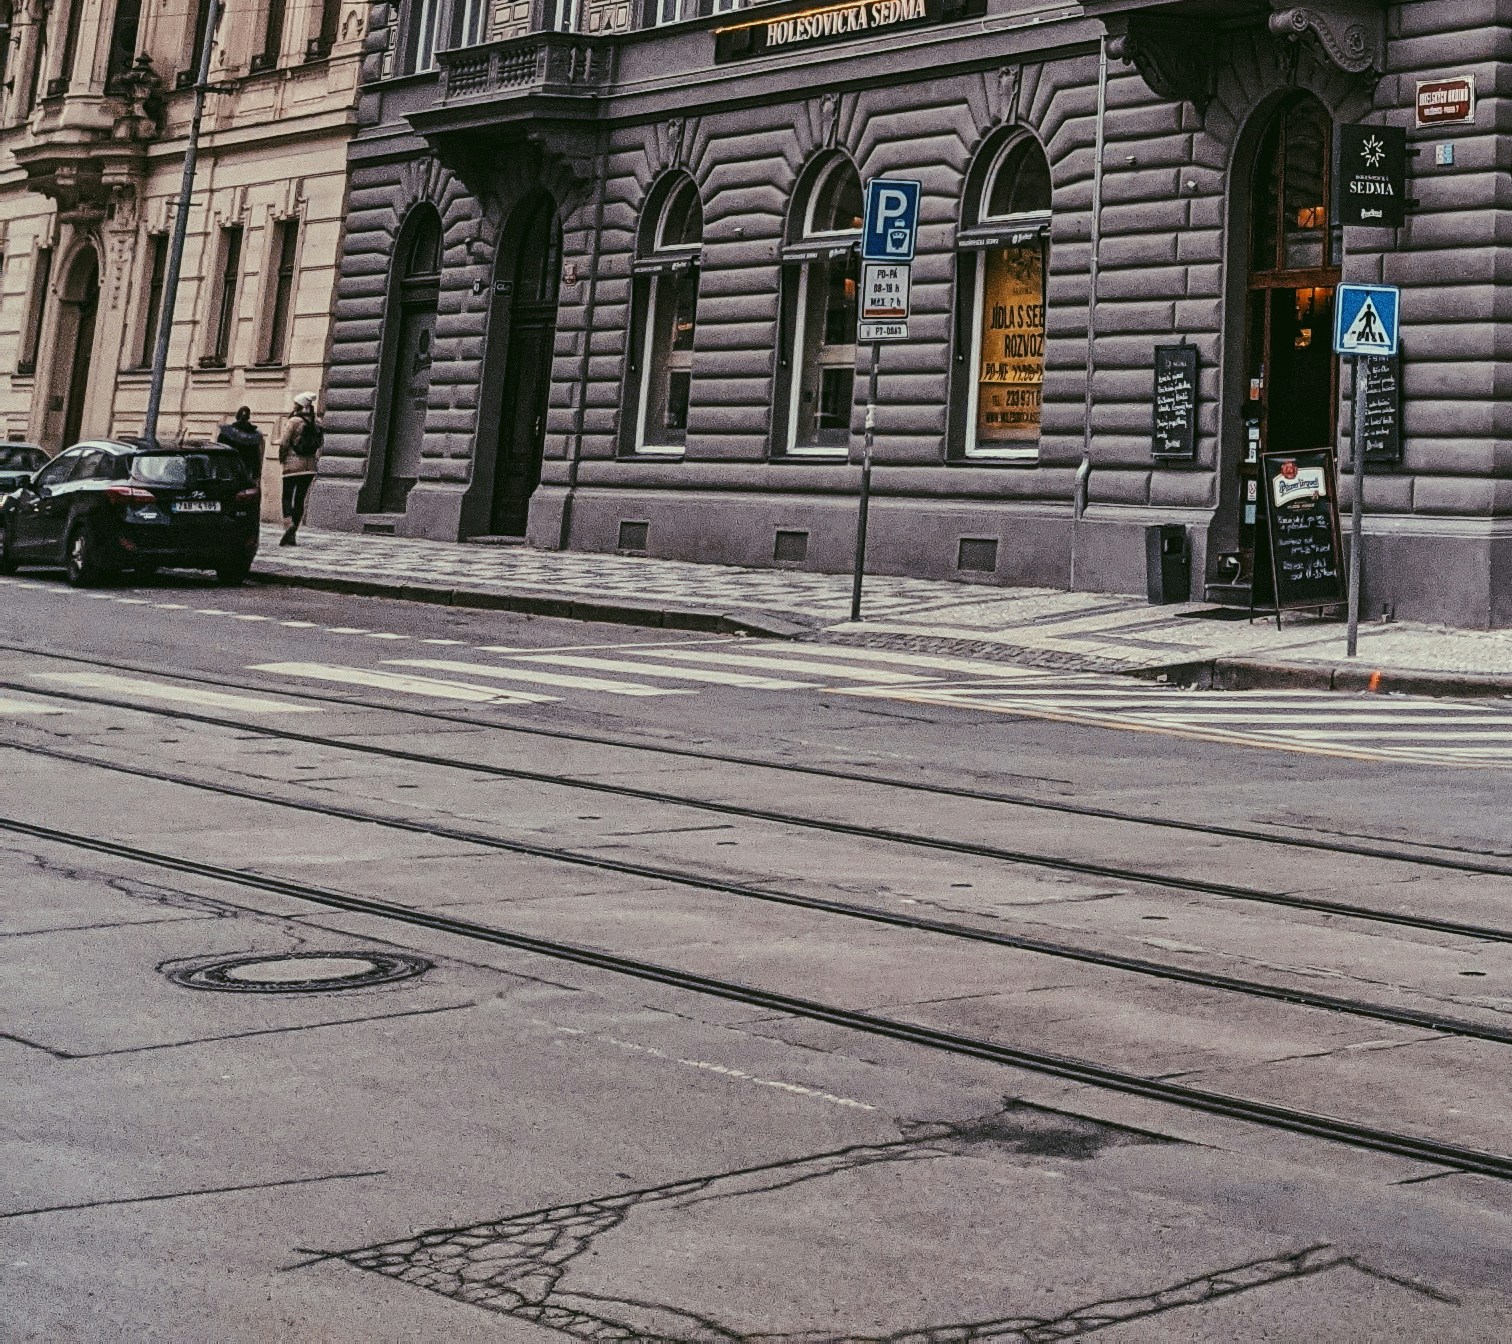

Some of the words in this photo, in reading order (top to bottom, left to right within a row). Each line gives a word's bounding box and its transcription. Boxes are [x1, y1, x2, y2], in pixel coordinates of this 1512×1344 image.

[1349, 181, 1394, 196] SEDMA
[876, 189, 908, 234] P
[990, 301, 1015, 329] JÍDLA
[1017, 304, 1024, 328] S
[1004, 333, 1044, 358] ROZVOZ
